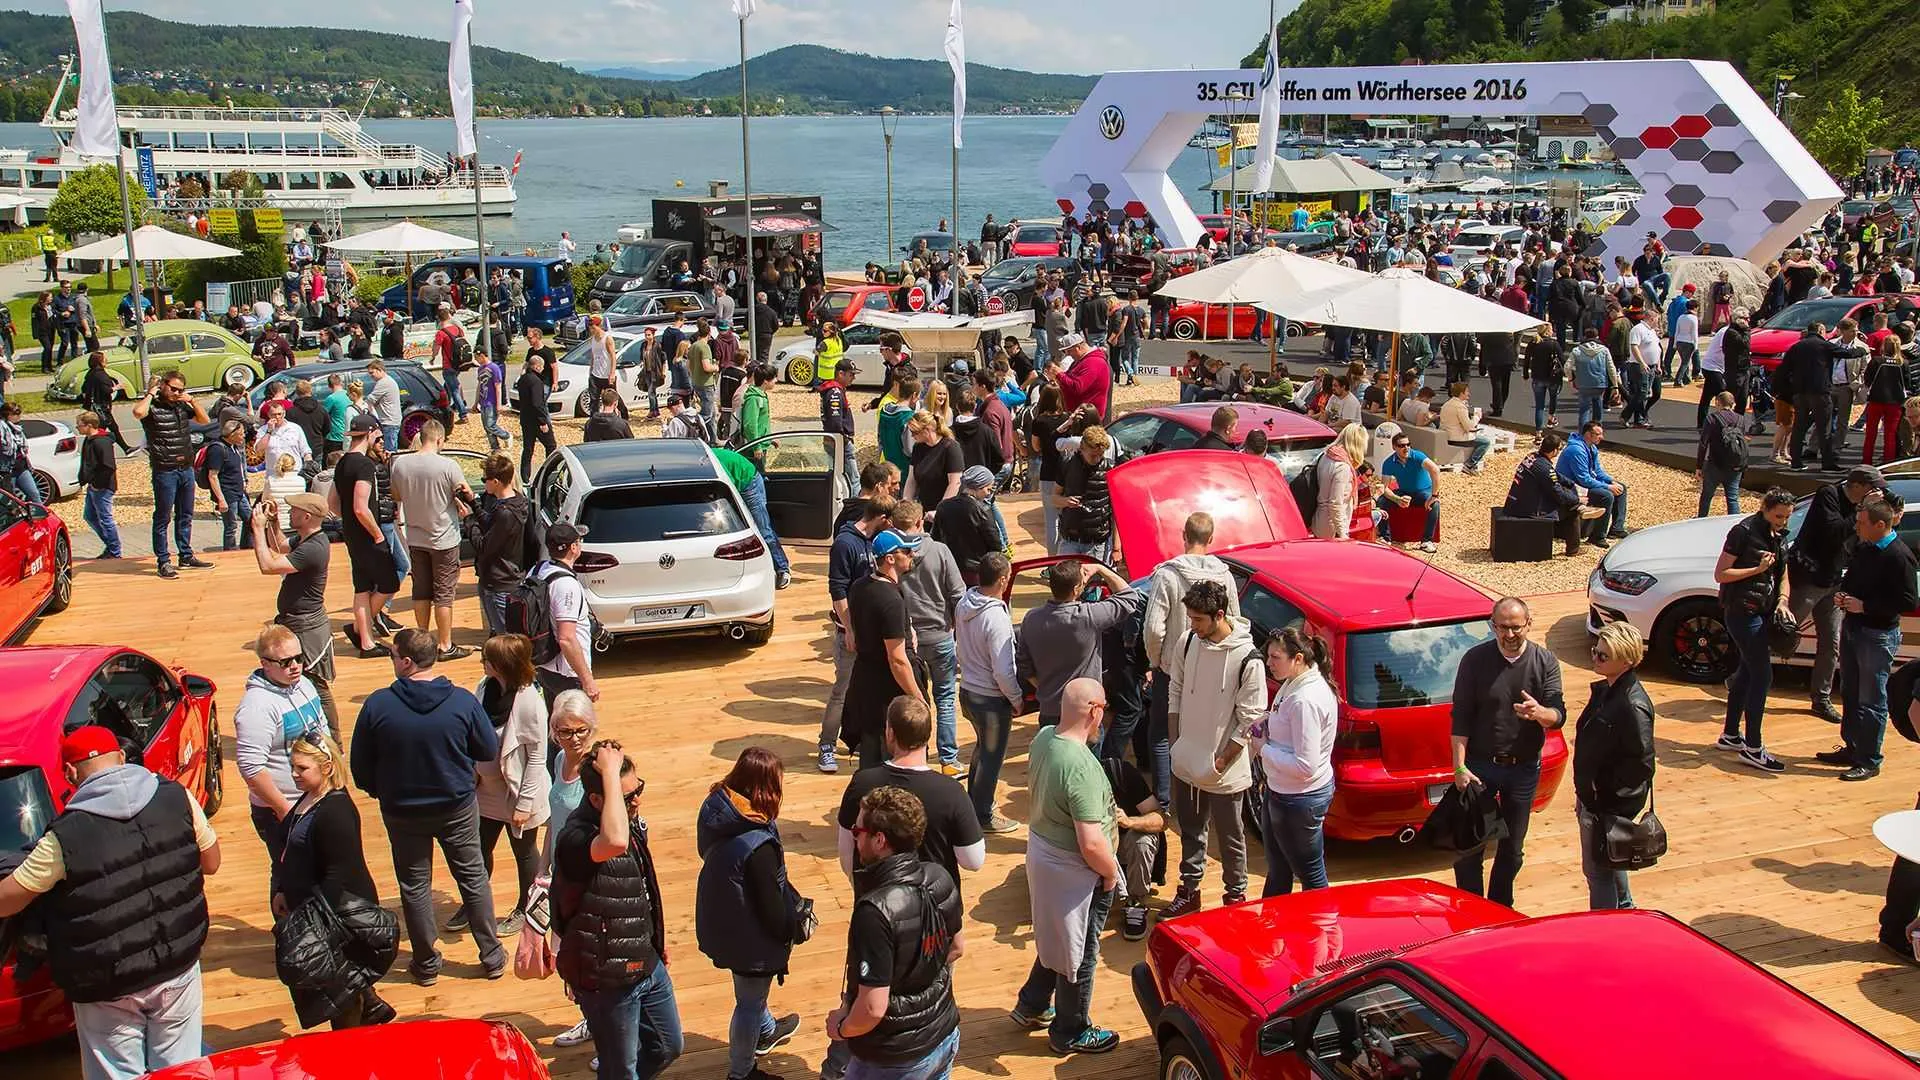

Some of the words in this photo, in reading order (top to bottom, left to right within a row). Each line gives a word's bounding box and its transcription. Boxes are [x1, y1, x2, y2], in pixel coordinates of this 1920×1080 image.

[1225, 81, 1256, 101] GTI
[1280, 80, 1318, 101] ffen
[1321, 87, 1352, 101] am
[1357, 78, 1468, 101] Wörthersee
[1473, 78, 1528, 101] 2016
[140, 154, 151, 193] REIFNITZ
[987, 302, 1004, 310] STOP
[1137, 366, 1160, 375] RIVE
[659, 607, 678, 615] GTI
